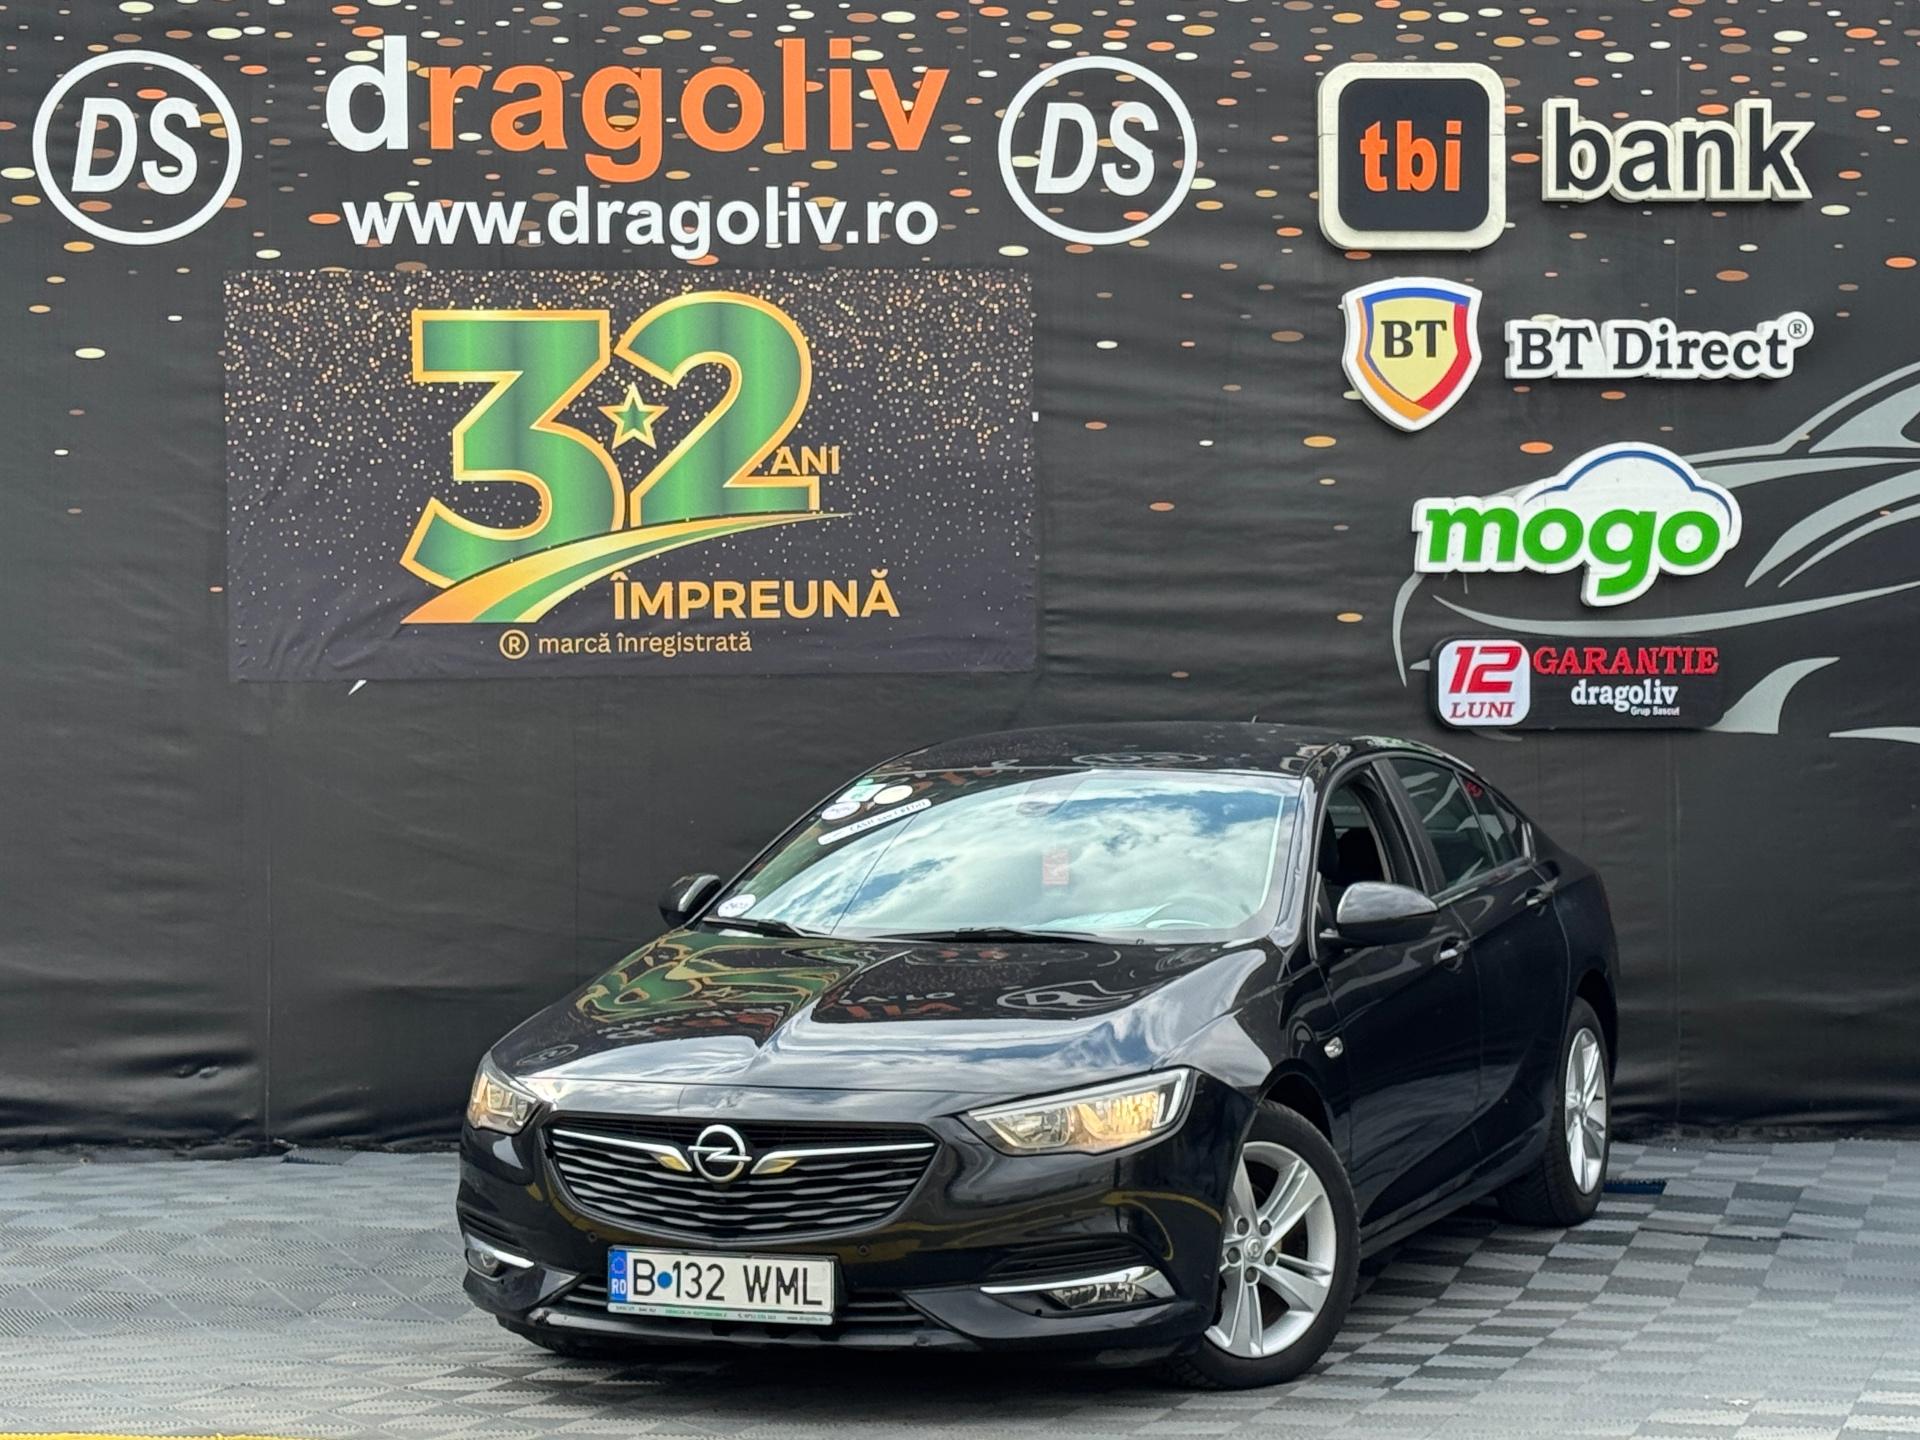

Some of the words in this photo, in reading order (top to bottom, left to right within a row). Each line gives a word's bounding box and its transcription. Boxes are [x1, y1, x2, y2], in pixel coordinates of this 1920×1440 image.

[326, 35, 950, 183] dragoliv
[71, 97, 201, 195] DS
[1034, 101, 1159, 196] DS
[1360, 120, 1463, 192] tbi
[1555, 106, 1802, 192] bank
[342, 186, 939, 260] www.dragoliv.ro
[1381, 320, 1447, 359] BT
[1516, 326, 1592, 371] BT
[400, 290, 820, 589] 32
[769, 445, 839, 476] ANI
[1425, 507, 1721, 597] mogo
[611, 569, 900, 620] ÎMPREUNĂ
[538, 634, 611, 655] marcă
[617, 632, 752, 658] înregistrată
[1533, 646, 1720, 675] GARANTIE
[1448, 646, 1522, 694] 12
[1450, 701, 1514, 719] LUNI
[1571, 678, 1679, 712] dragoliv
[611, 1278, 627, 1295] RO
[633, 1259, 656, 1296] B
[672, 1261, 725, 1301] 132
[743, 1265, 823, 1306] WML
